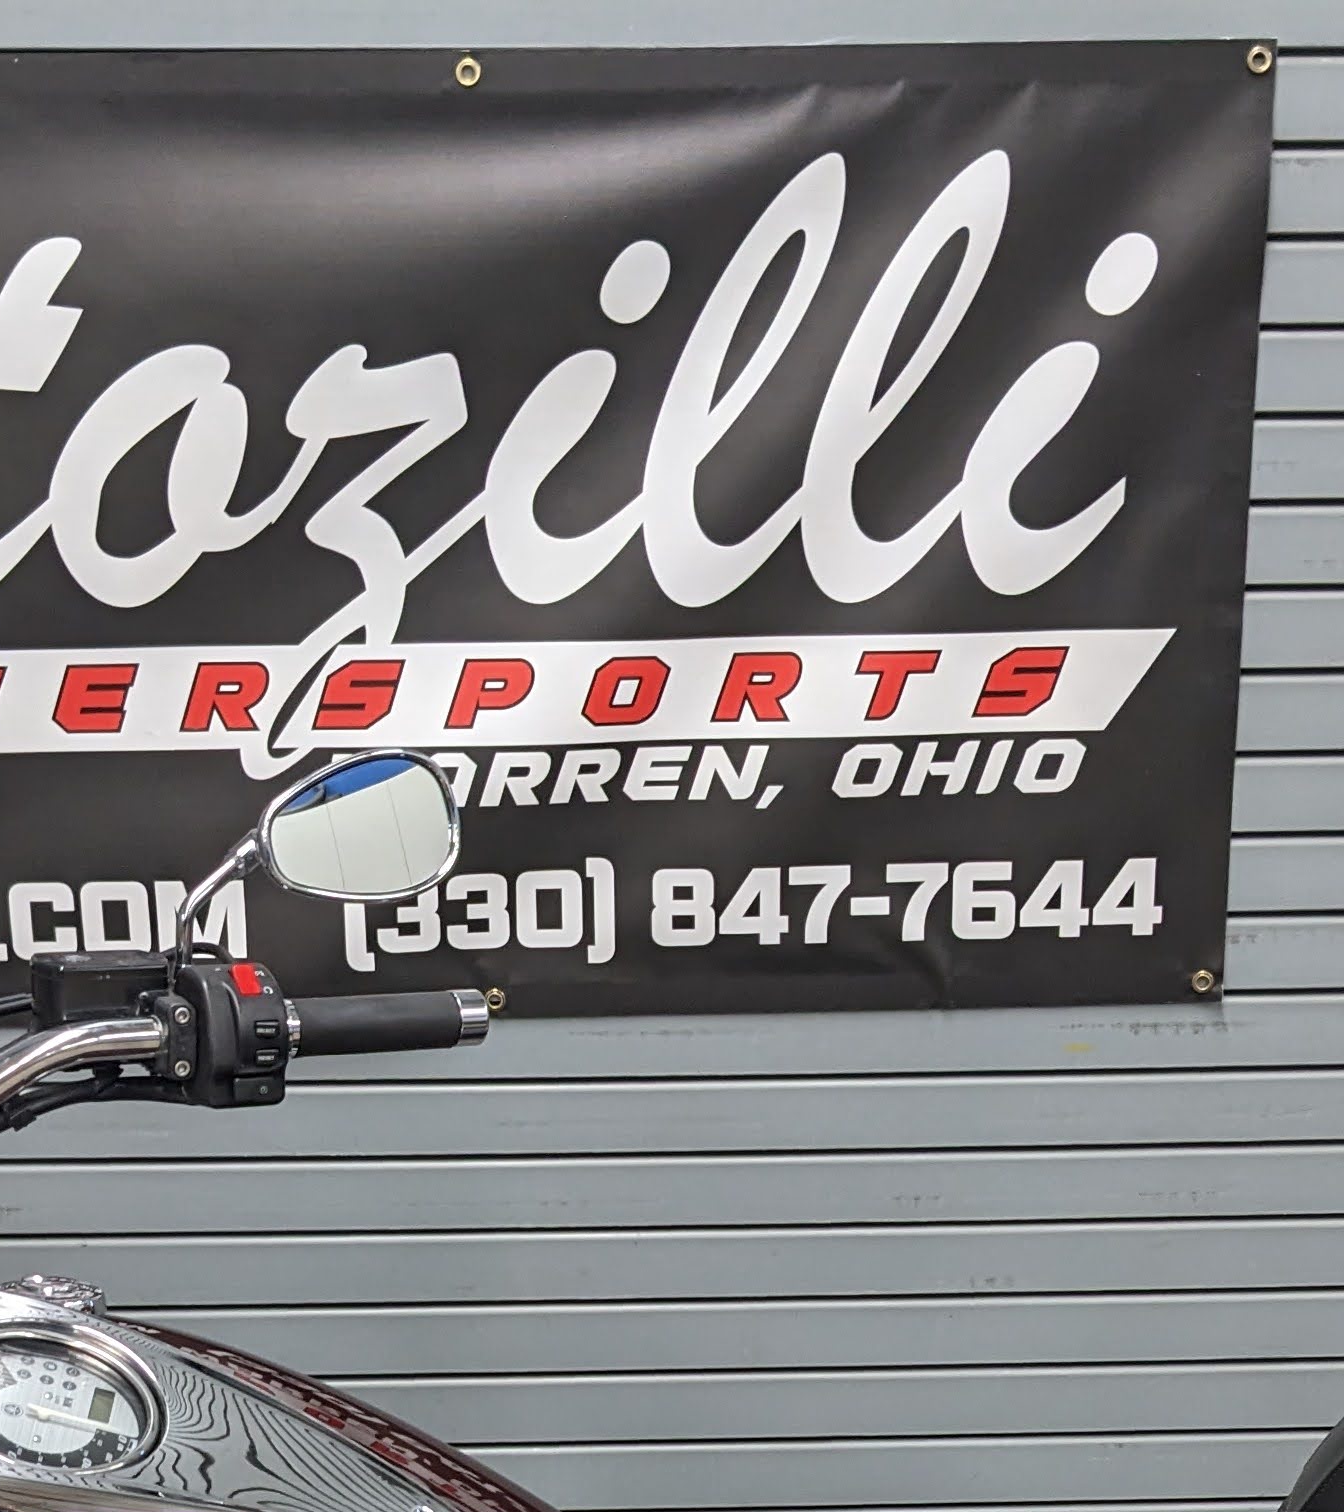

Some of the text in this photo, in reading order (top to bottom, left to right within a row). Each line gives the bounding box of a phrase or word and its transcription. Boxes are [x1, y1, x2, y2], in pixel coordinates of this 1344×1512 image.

[331, 737, 1088, 810] ARREN, OHIO
[343, 856, 615, 973] (330)
[650, 857, 1164, 948] 847-7644
